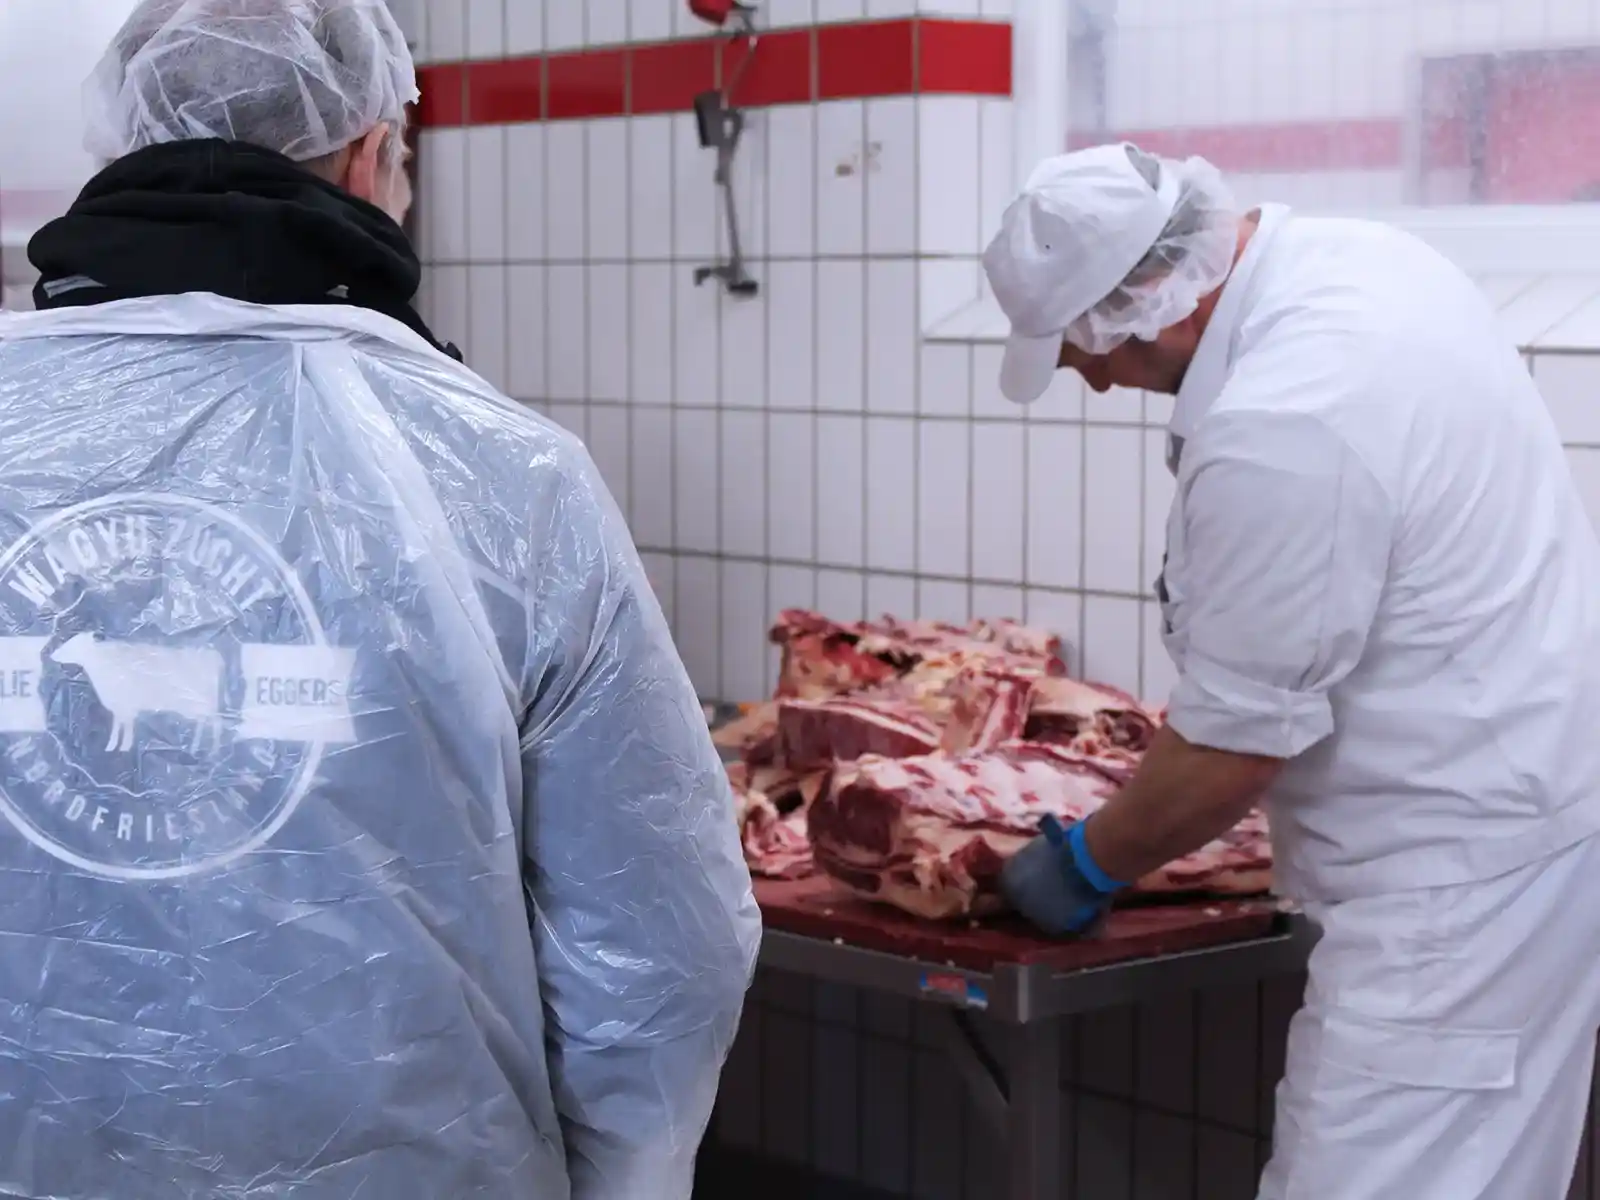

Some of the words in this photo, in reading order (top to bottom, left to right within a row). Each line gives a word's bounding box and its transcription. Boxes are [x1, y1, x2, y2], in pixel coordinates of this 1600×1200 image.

[7, 516, 151, 607] WAGYU
[162, 516, 277, 610] ZUCHT
[256, 676, 342, 706] EGGERS
